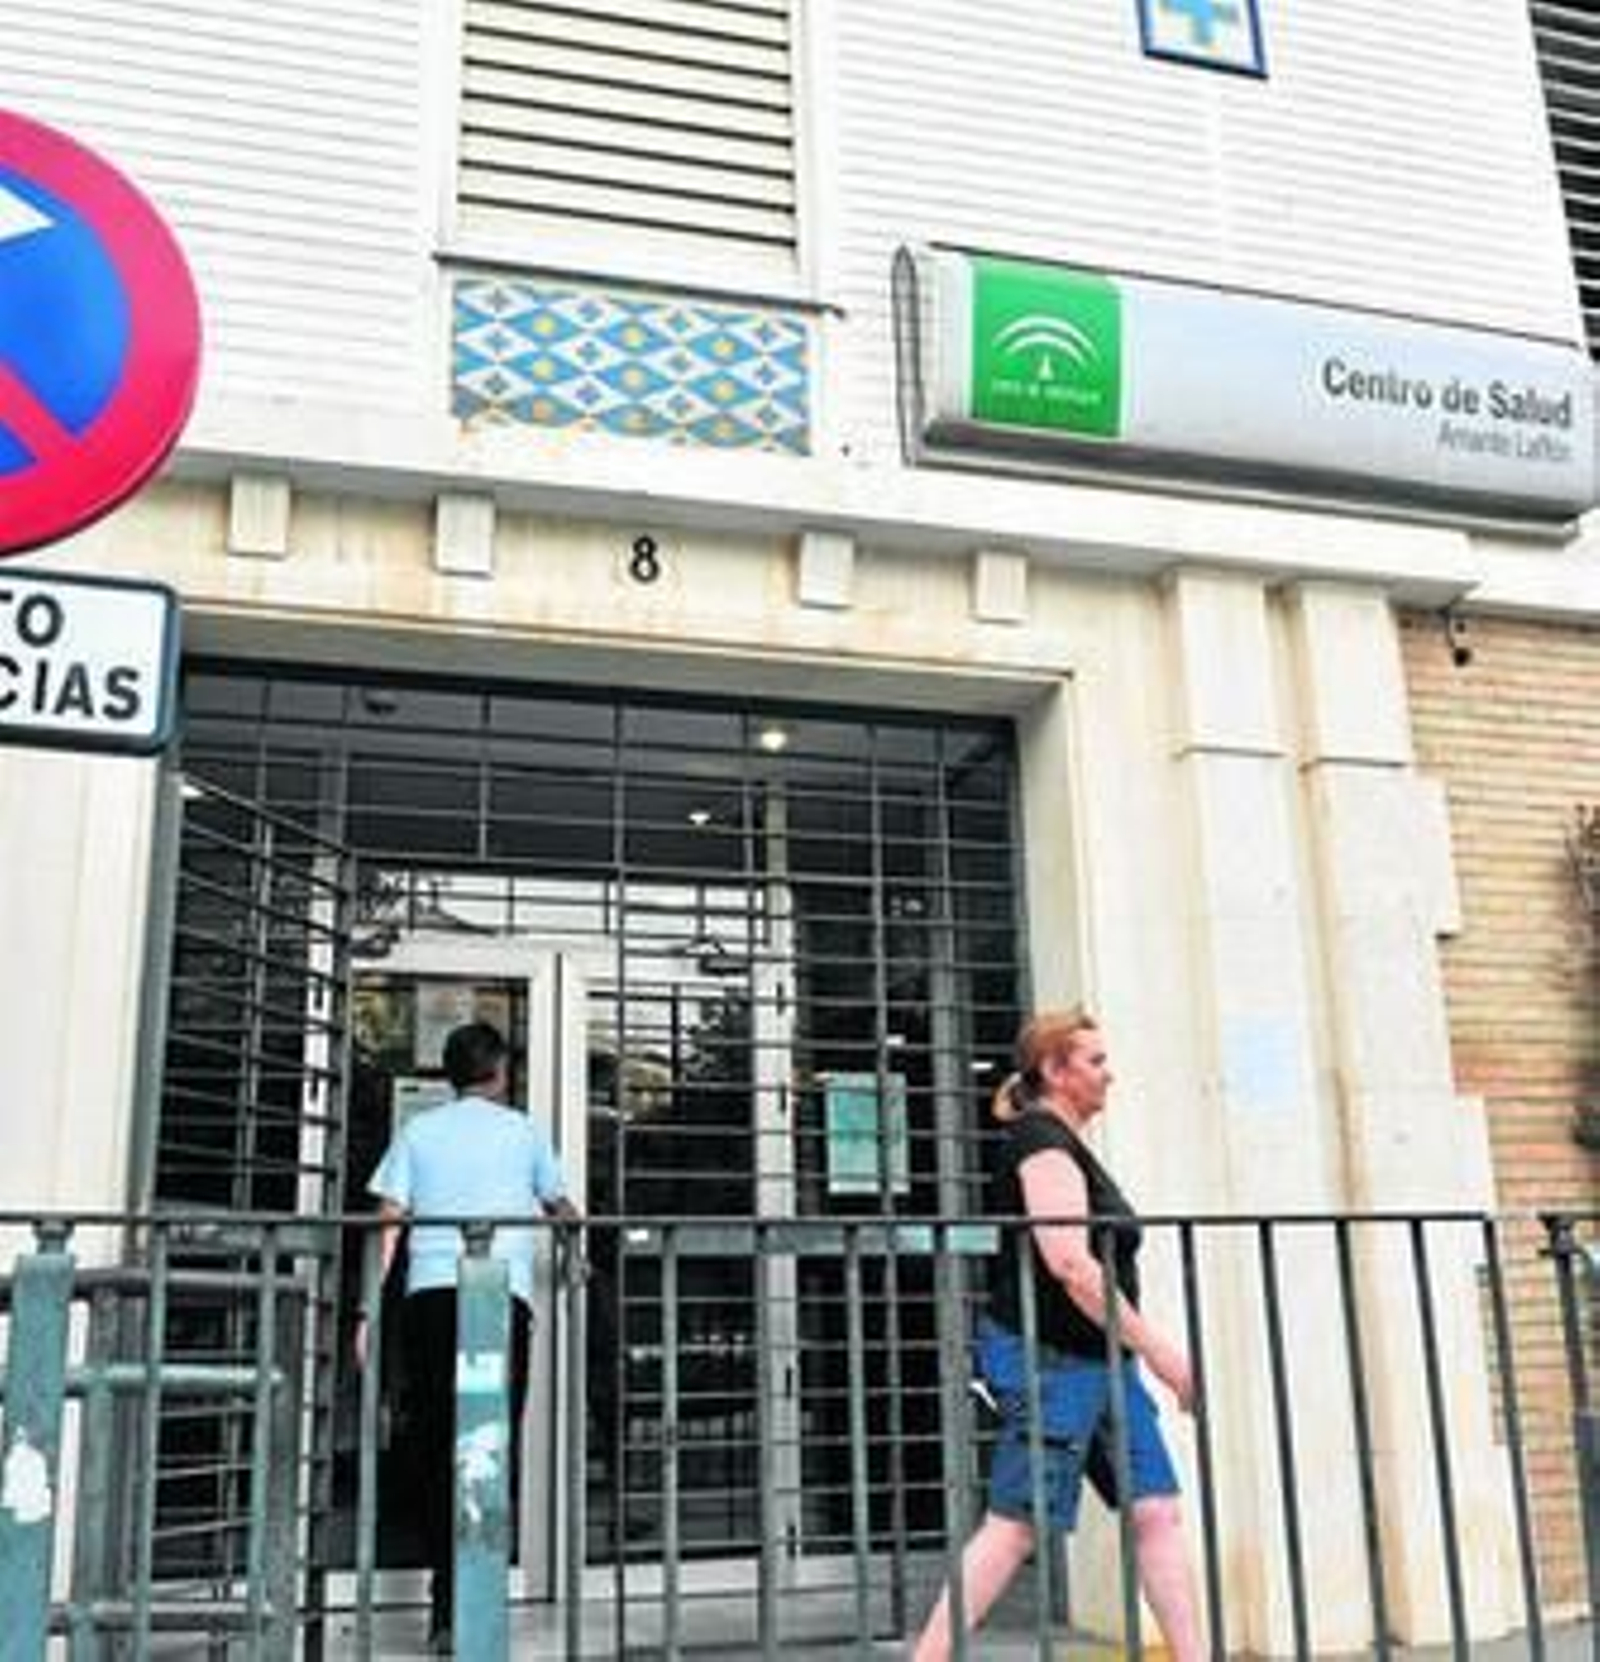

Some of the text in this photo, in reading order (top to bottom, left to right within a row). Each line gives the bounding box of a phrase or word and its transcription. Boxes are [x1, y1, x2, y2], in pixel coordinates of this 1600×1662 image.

[1322, 357, 1571, 430] Centro de Salud
[628, 535, 661, 584] 8
